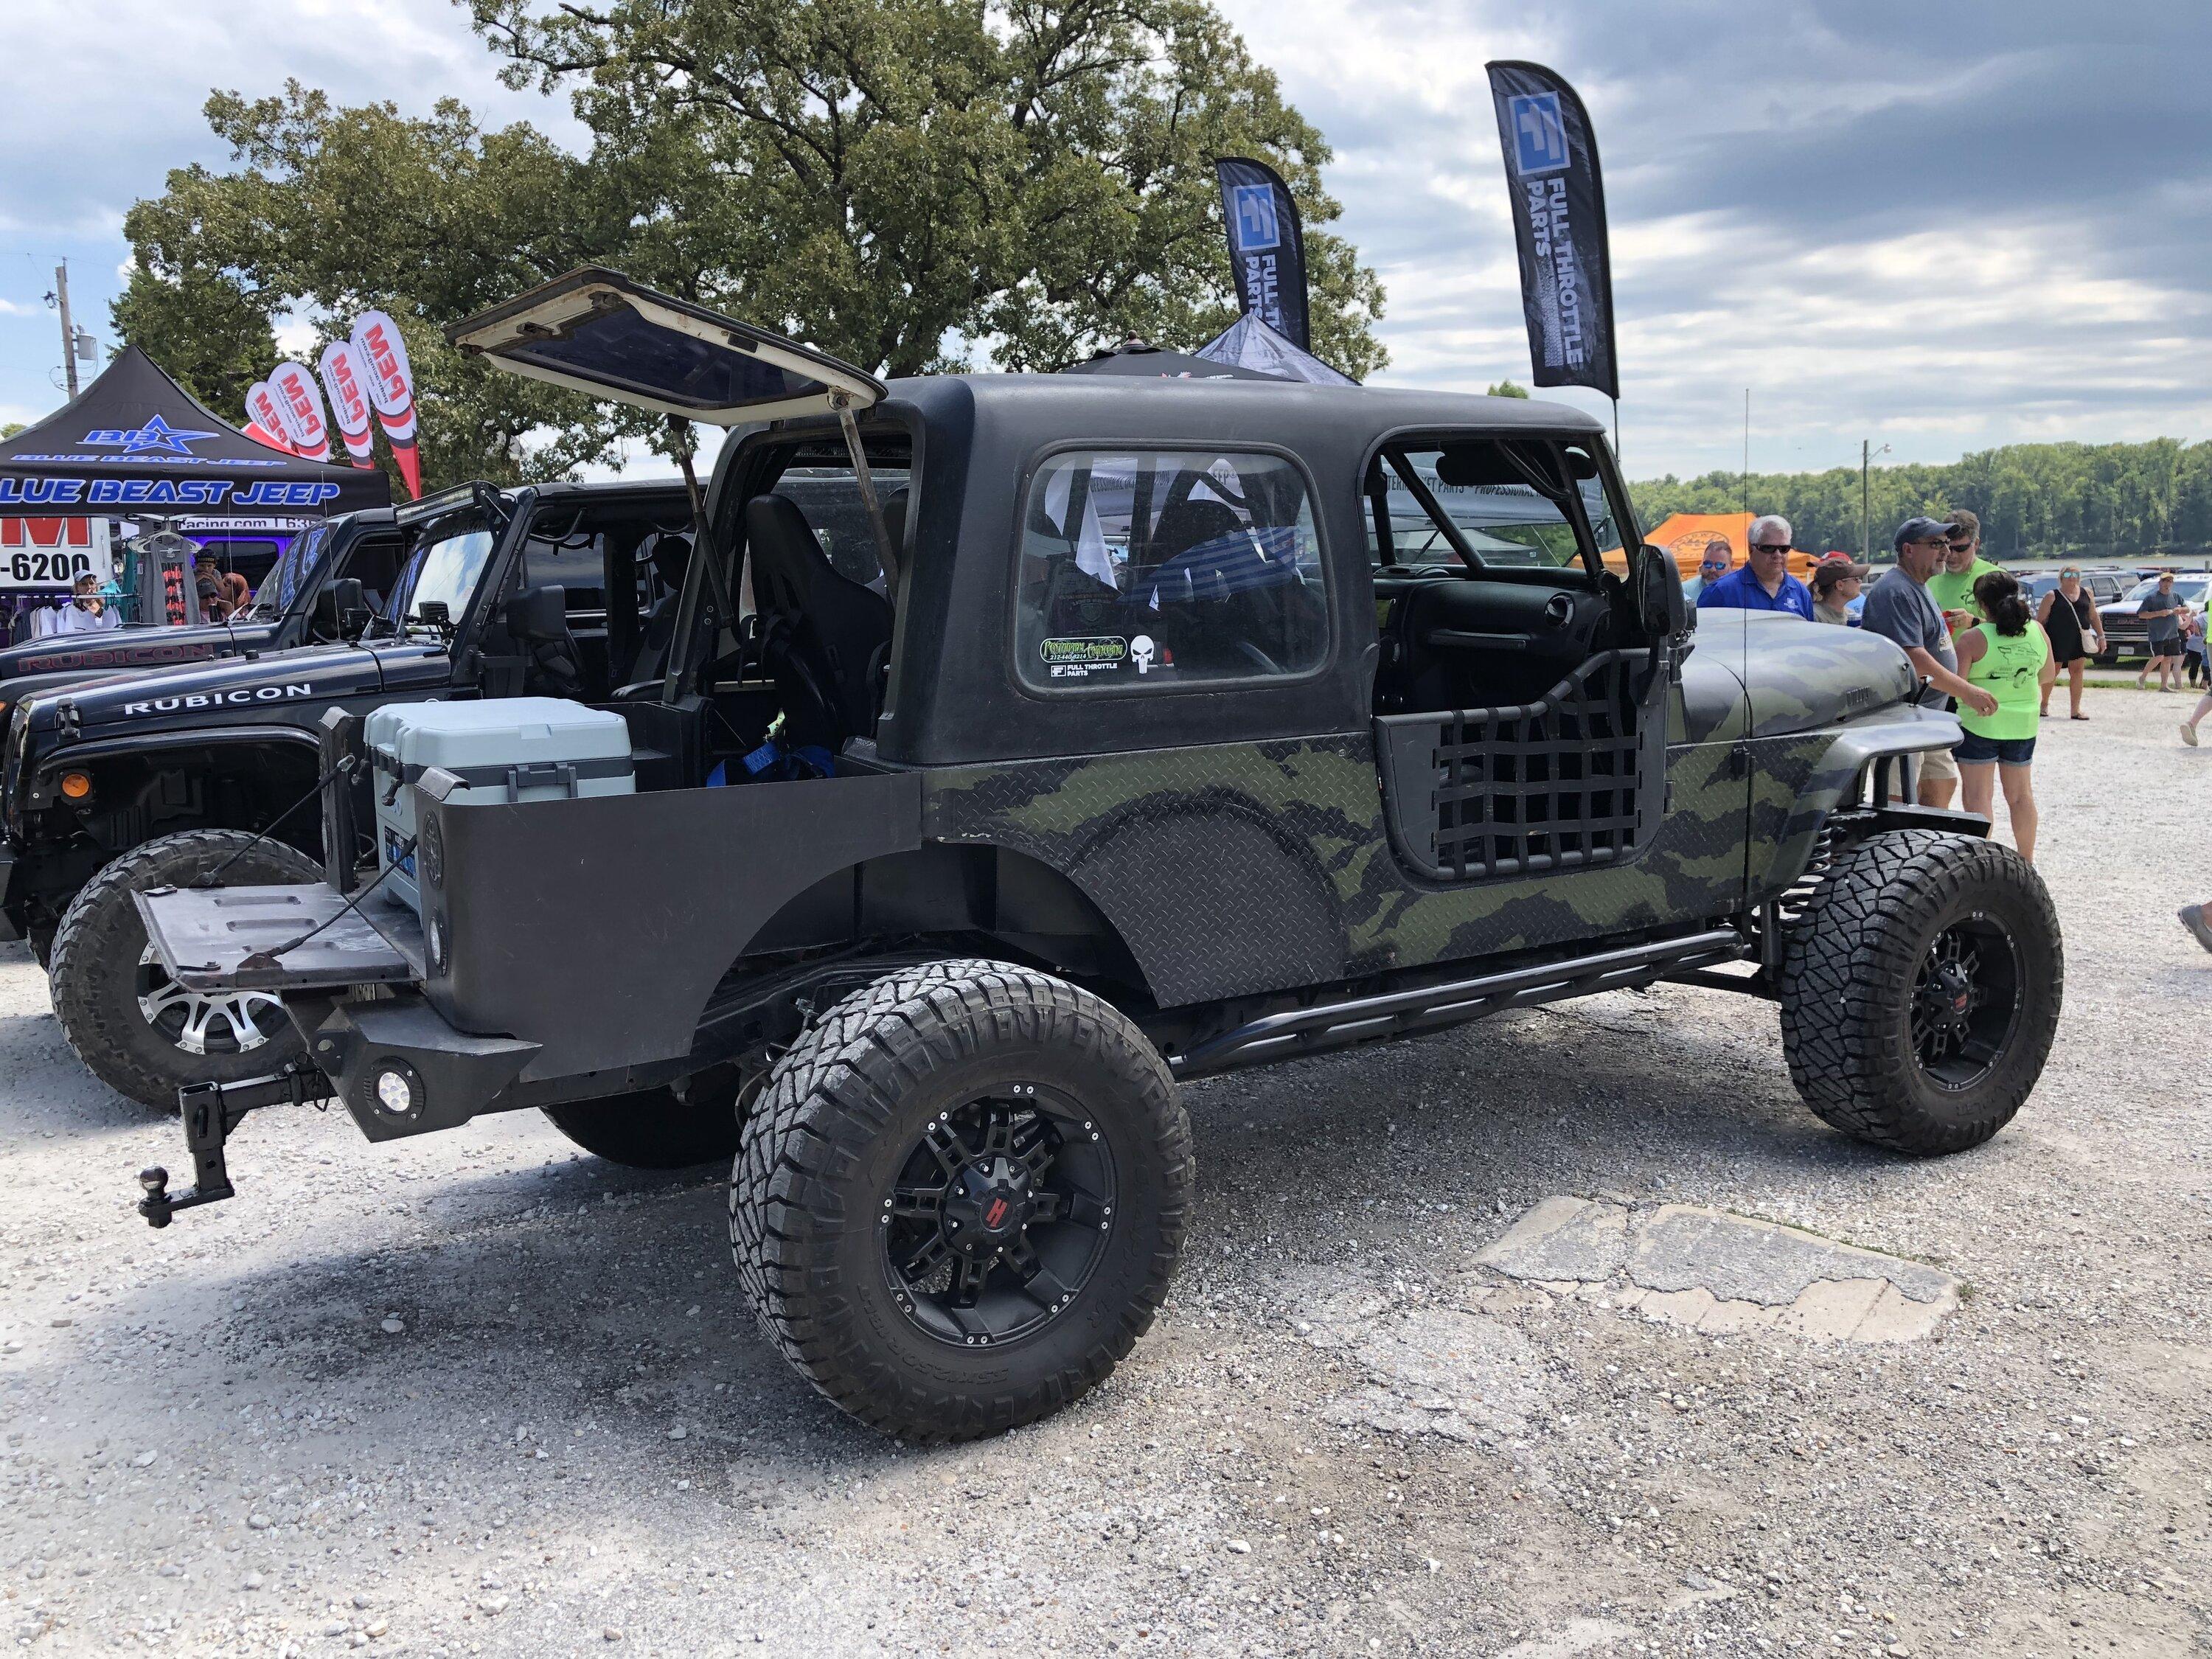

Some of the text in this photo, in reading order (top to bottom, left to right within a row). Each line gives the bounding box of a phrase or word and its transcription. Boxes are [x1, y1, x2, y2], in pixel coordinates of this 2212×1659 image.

[1527, 180, 1551, 257] PARTS
[1245, 256, 1264, 319] PARTS
[1262, 254, 1279, 304] FULL
[1548, 177, 1584, 364] FULL THROTTLE
[100, 454, 208, 465] BEAST
[206, 458, 288, 466] JEEP
[87, 479, 234, 504] BEAST
[232, 481, 341, 506] JEEP
[18, 644, 216, 672] RUBICON
[125, 684, 311, 715] RUBICON
